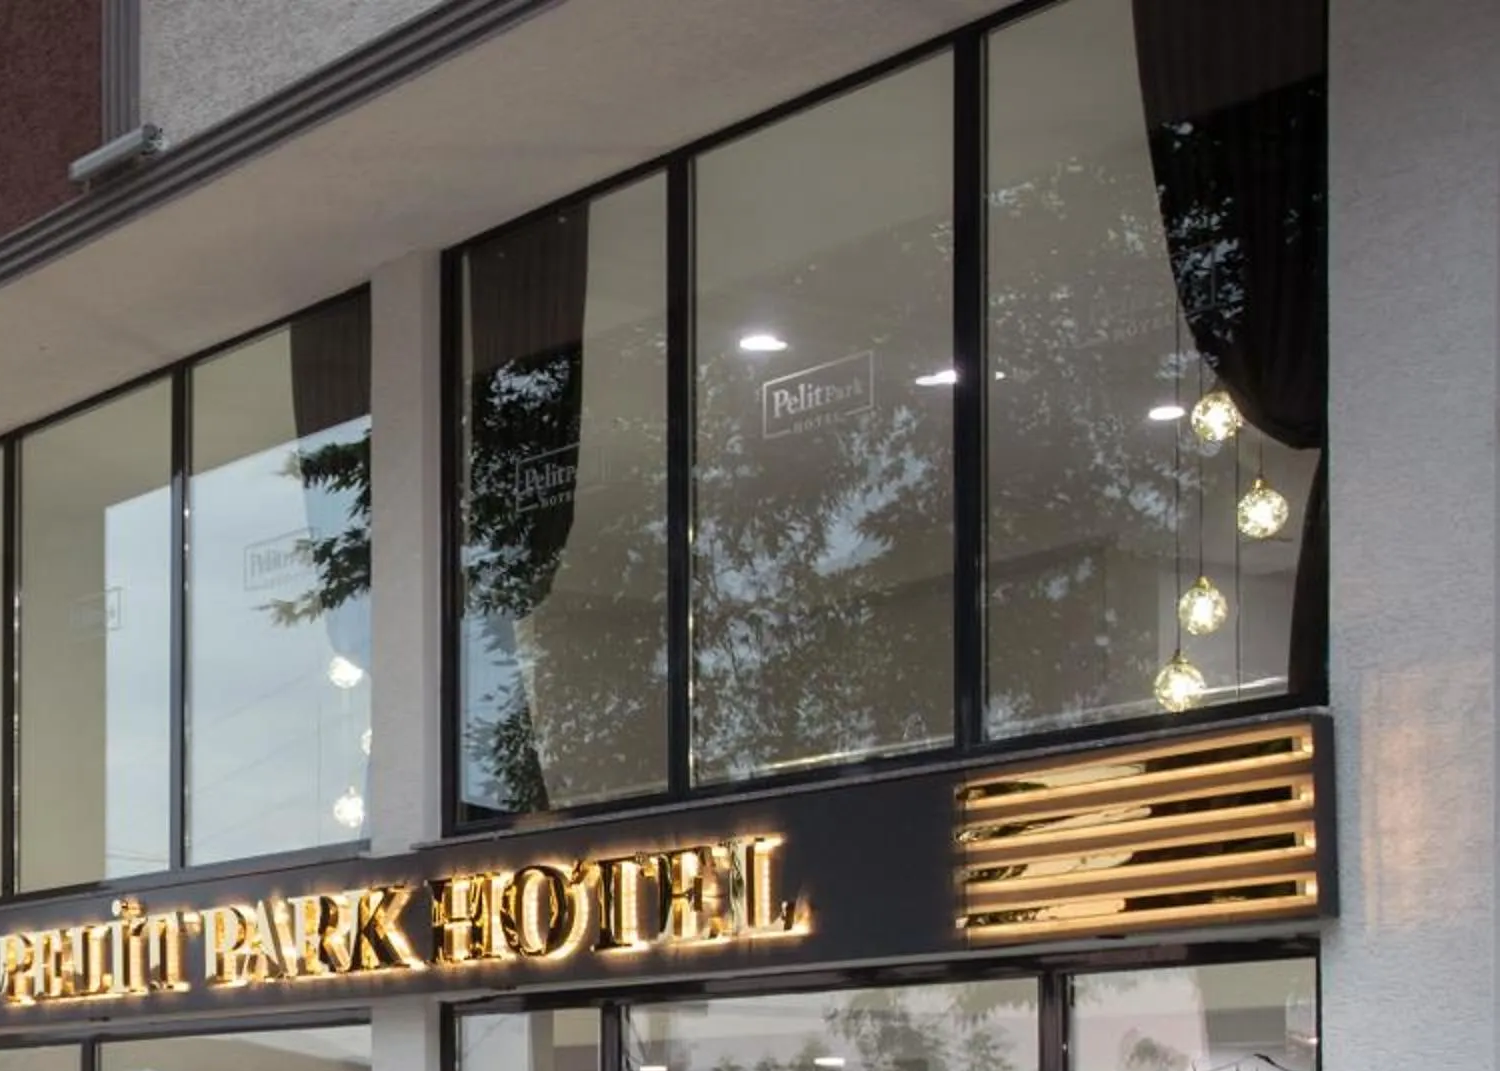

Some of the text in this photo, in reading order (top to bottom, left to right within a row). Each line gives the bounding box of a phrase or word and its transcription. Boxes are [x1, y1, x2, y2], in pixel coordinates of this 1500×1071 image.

[772, 383, 824, 418] Pelit
[199, 884, 428, 988] PARK
[426, 834, 812, 964] HOTEL
